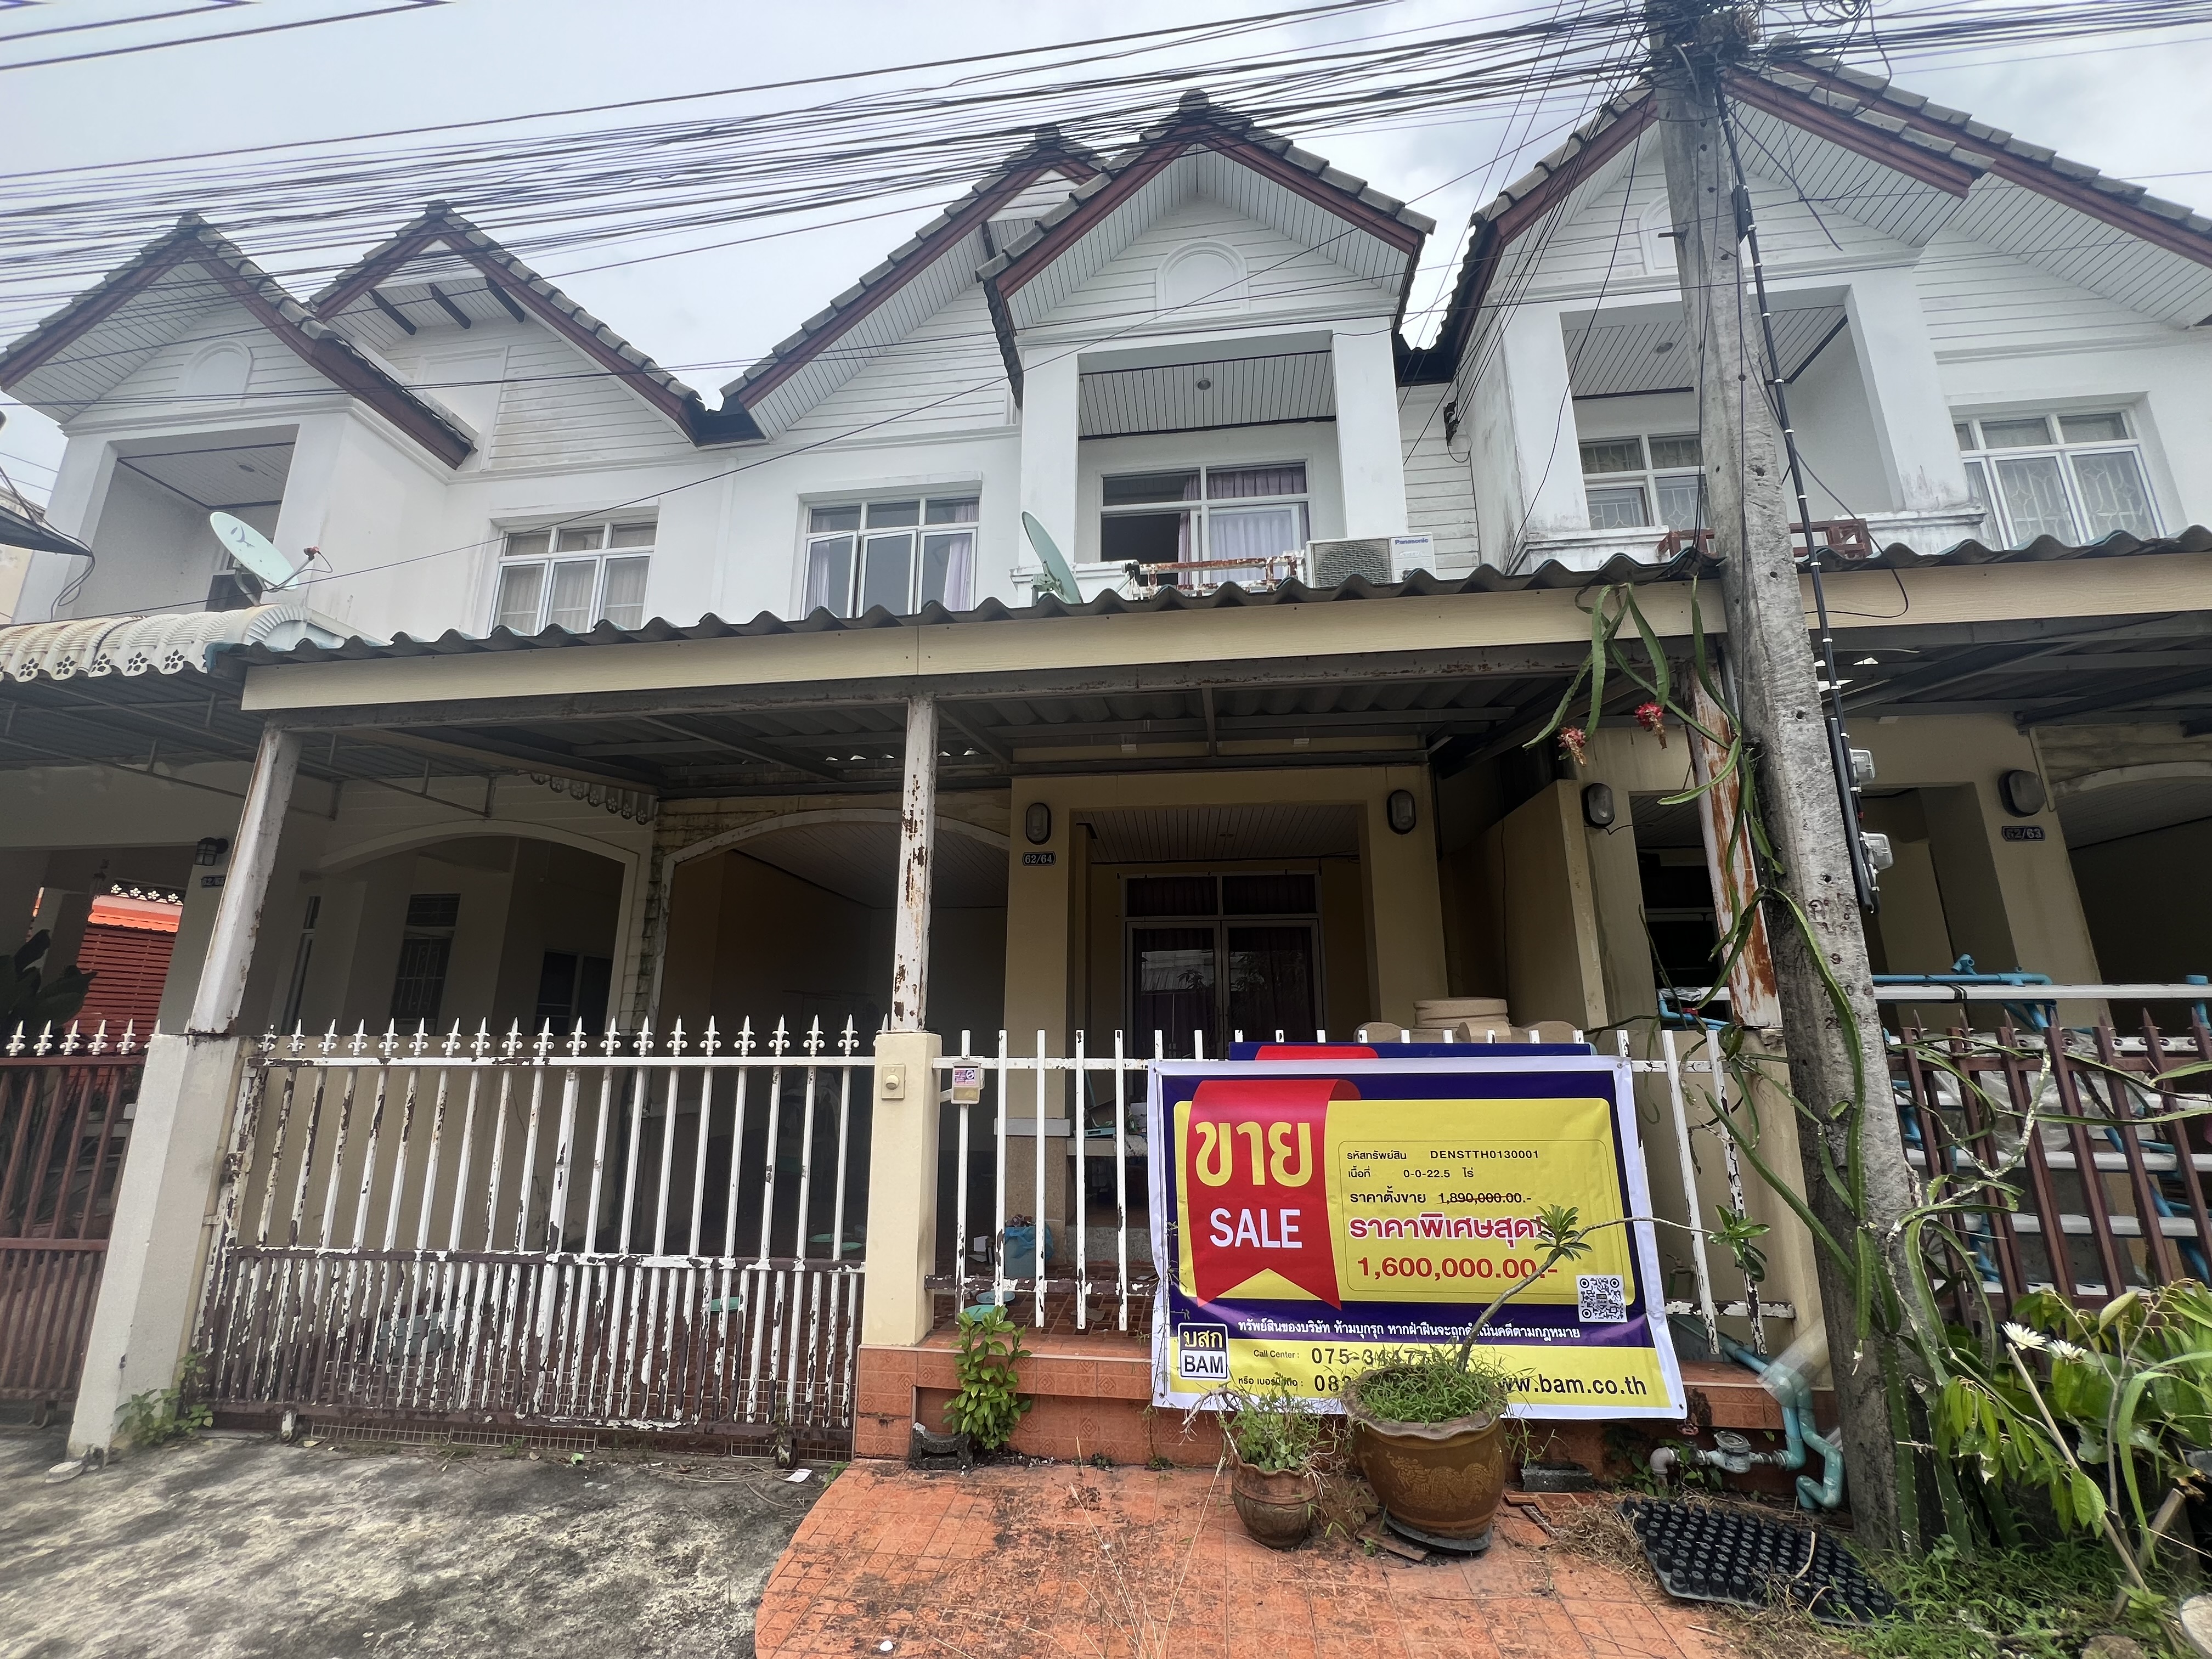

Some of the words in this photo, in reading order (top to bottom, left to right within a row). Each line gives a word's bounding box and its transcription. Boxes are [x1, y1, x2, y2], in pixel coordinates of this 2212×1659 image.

[2006, 828, 2042, 840] 62/63
[1025, 854, 1052, 864] 62/64
[1195, 1121, 1313, 1187] ขาย
[1347, 1150, 1407, 1160] รหัสทรัพย์สิน
[1430, 1150, 1539, 1159] DENSTTH0130001
[1348, 1165, 1371, 1178] เนื้อที่
[1403, 1169, 1451, 1178] 0-0-22.5
[1462, 1167, 1474, 1178] ไร่
[1350, 1185, 1426, 1204] ราคาตั้งขาย
[1210, 1207, 1302, 1249] SALE
[1357, 1256, 1558, 1282] 1,600,000.00.-
[1238, 1317, 1331, 1334] ทรัพย์สินของบริษัท
[1334, 1319, 1384, 1340] ห้ามบุกรุก
[1183, 1330, 1223, 1348] บสก
[1269, 1350, 1295, 1359] Center
[1184, 1355, 1223, 1373] BAM
[1238, 1375, 1254, 1385] หรือ
[1498, 1373, 1647, 1395] ww.bam.co.th
